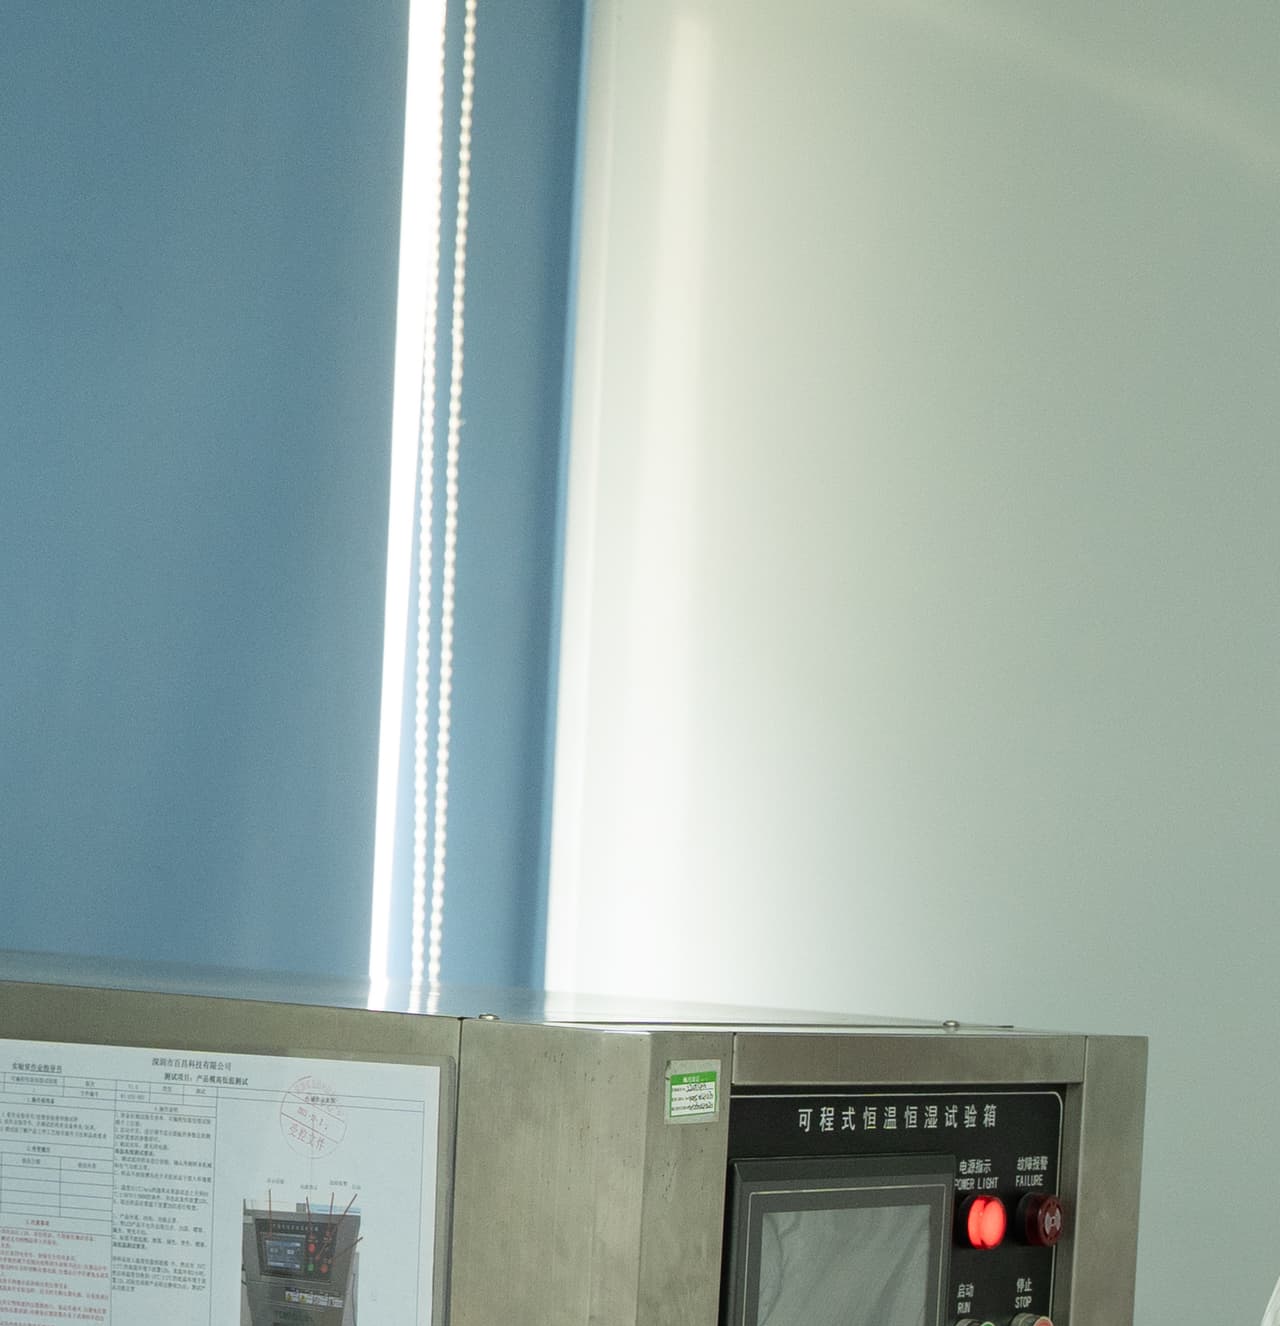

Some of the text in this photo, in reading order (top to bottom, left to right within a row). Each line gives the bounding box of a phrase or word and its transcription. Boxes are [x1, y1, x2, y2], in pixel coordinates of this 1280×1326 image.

[797, 1103, 997, 1133] 可程式恒温恒湿试验箱
[959, 1158, 992, 1175] 电源指示
[1016, 1155, 1049, 1172] 故障报警
[977, 1176, 999, 1190] LIGHT
[1015, 1174, 1044, 1187] FAILURE
[956, 1282, 975, 1298] 启动
[1016, 1277, 1033, 1293] 停止
[957, 1302, 971, 1314] RUN
[1014, 1296, 1032, 1309] STOP
